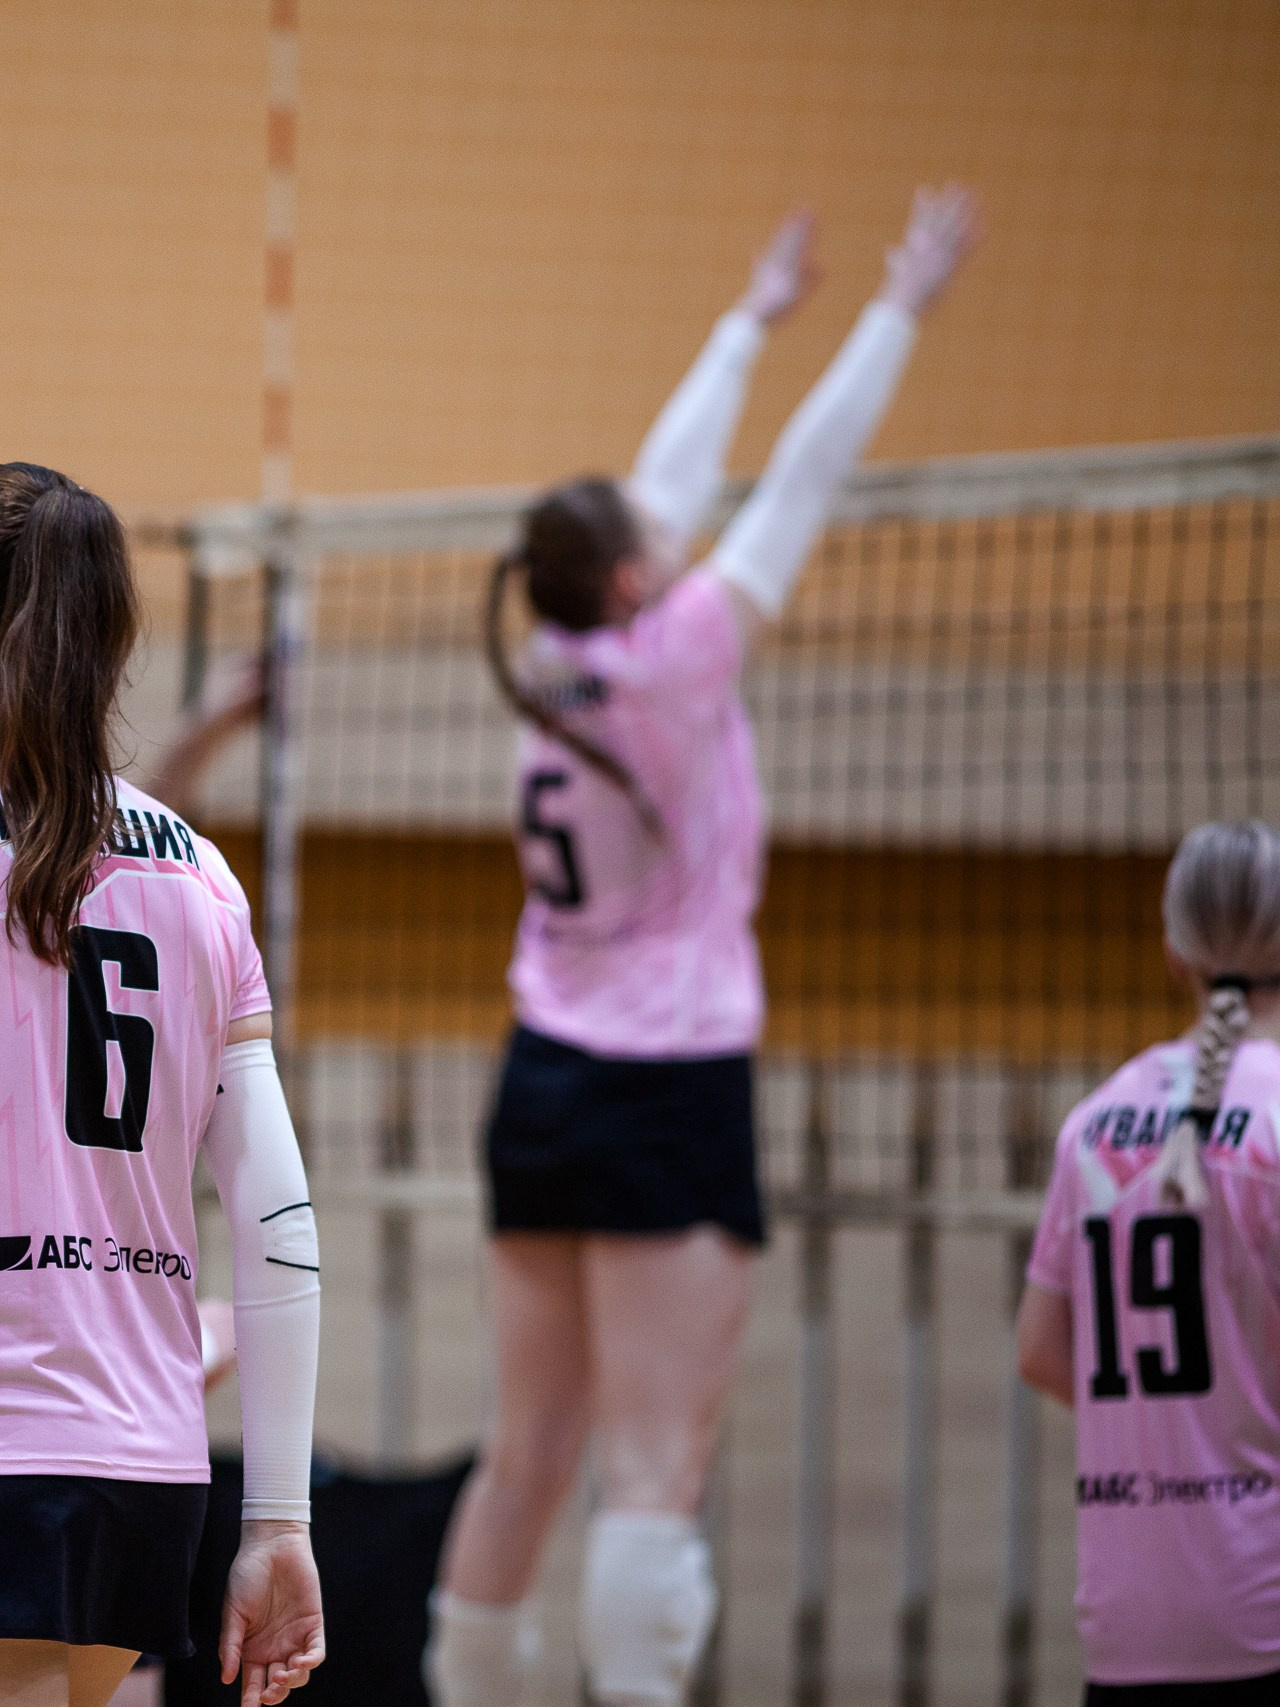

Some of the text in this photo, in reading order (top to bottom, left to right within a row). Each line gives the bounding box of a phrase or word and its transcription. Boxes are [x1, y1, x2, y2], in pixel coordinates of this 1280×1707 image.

[65, 925, 159, 1152] 6
[37, 1235, 93, 1271] АБС
[1083, 1214, 1213, 1399] 19
